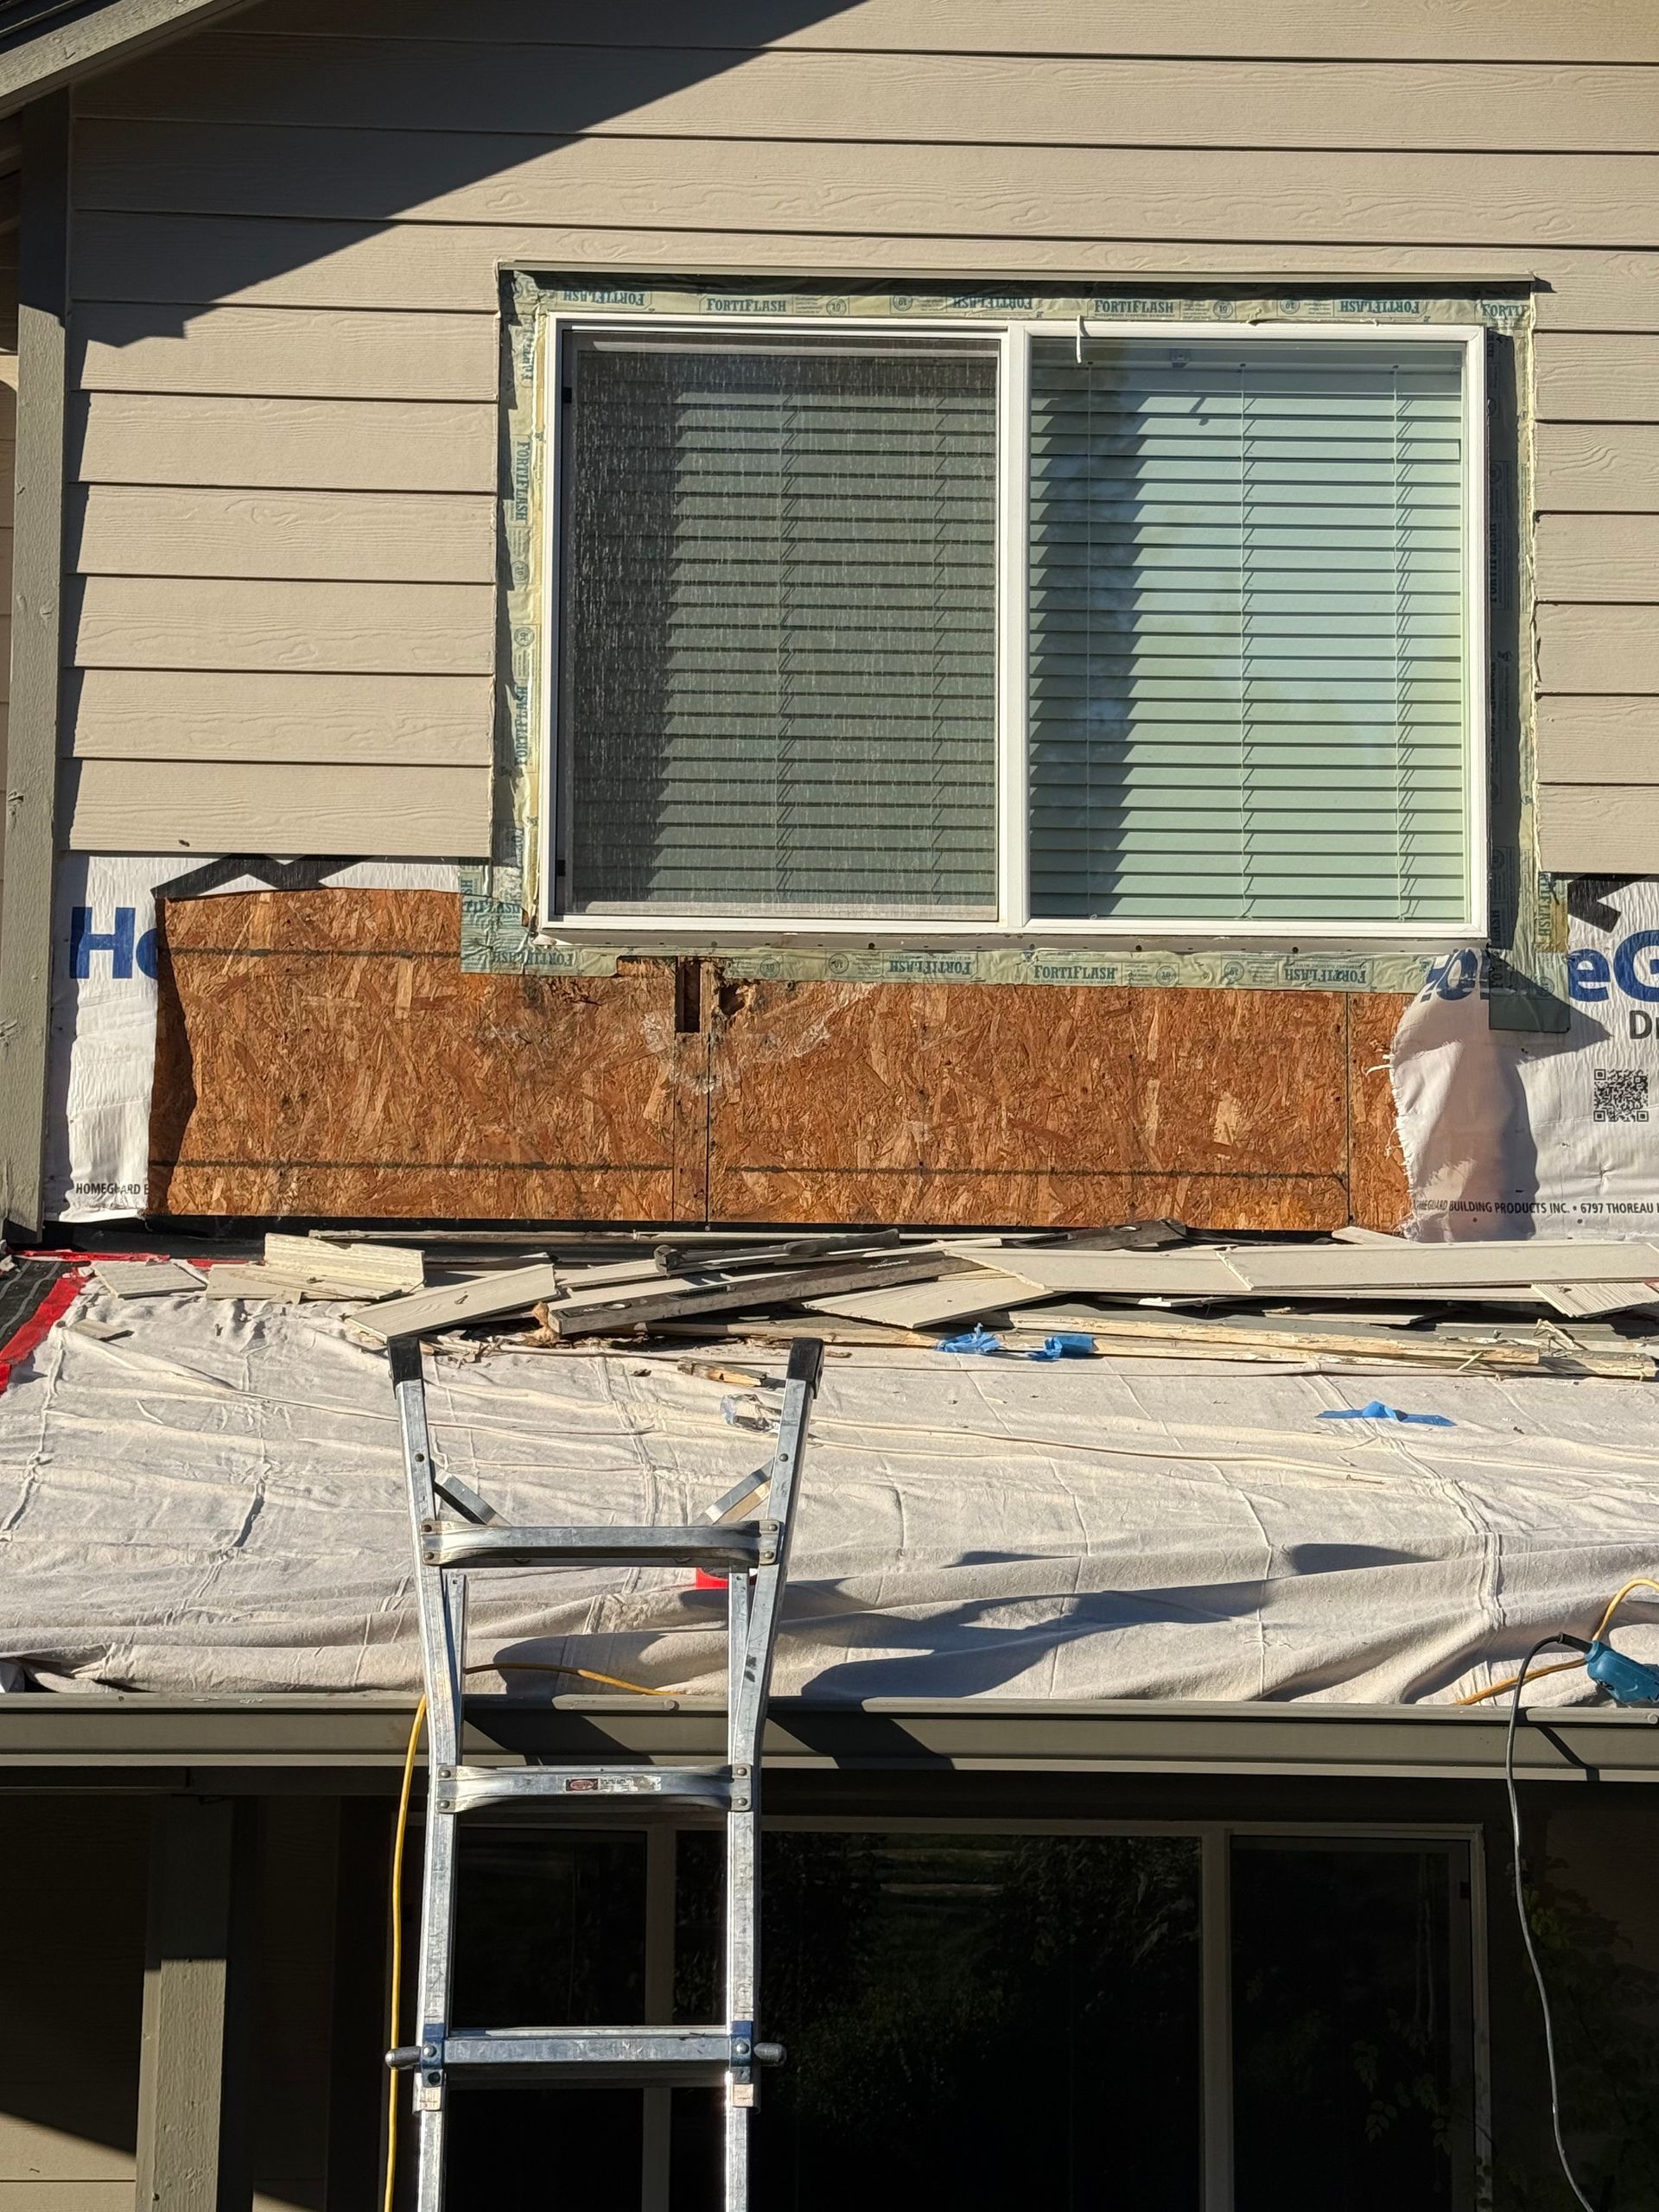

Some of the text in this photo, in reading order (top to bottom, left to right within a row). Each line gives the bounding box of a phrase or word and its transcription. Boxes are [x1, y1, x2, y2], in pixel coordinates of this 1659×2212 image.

[706, 298, 786, 312] FORTIFLASH
[1094, 299, 1173, 314] FORTIFLASH
[1340, 300, 1420, 314] FORTIFLASH
[516, 442, 531, 521] FORTIFLASH
[514, 685, 528, 766] FORTIFLASH
[889, 959, 971, 976] FORTIFLASH
[1033, 964, 1118, 981] FORTIFLASH
[1284, 967, 1366, 984] FORTIFLASH
[1630, 1010, 1659, 1039] D
[75, 1182, 141, 1195] HOMEGUARD
[1449, 1200, 1492, 1213] BUILDING
[1494, 1202, 1547, 1214] PRODUCTS
[1549, 1202, 1570, 1214] INC.
[1580, 1202, 1604, 1214] 6797
[1605, 1202, 1654, 1214] THOREAU
